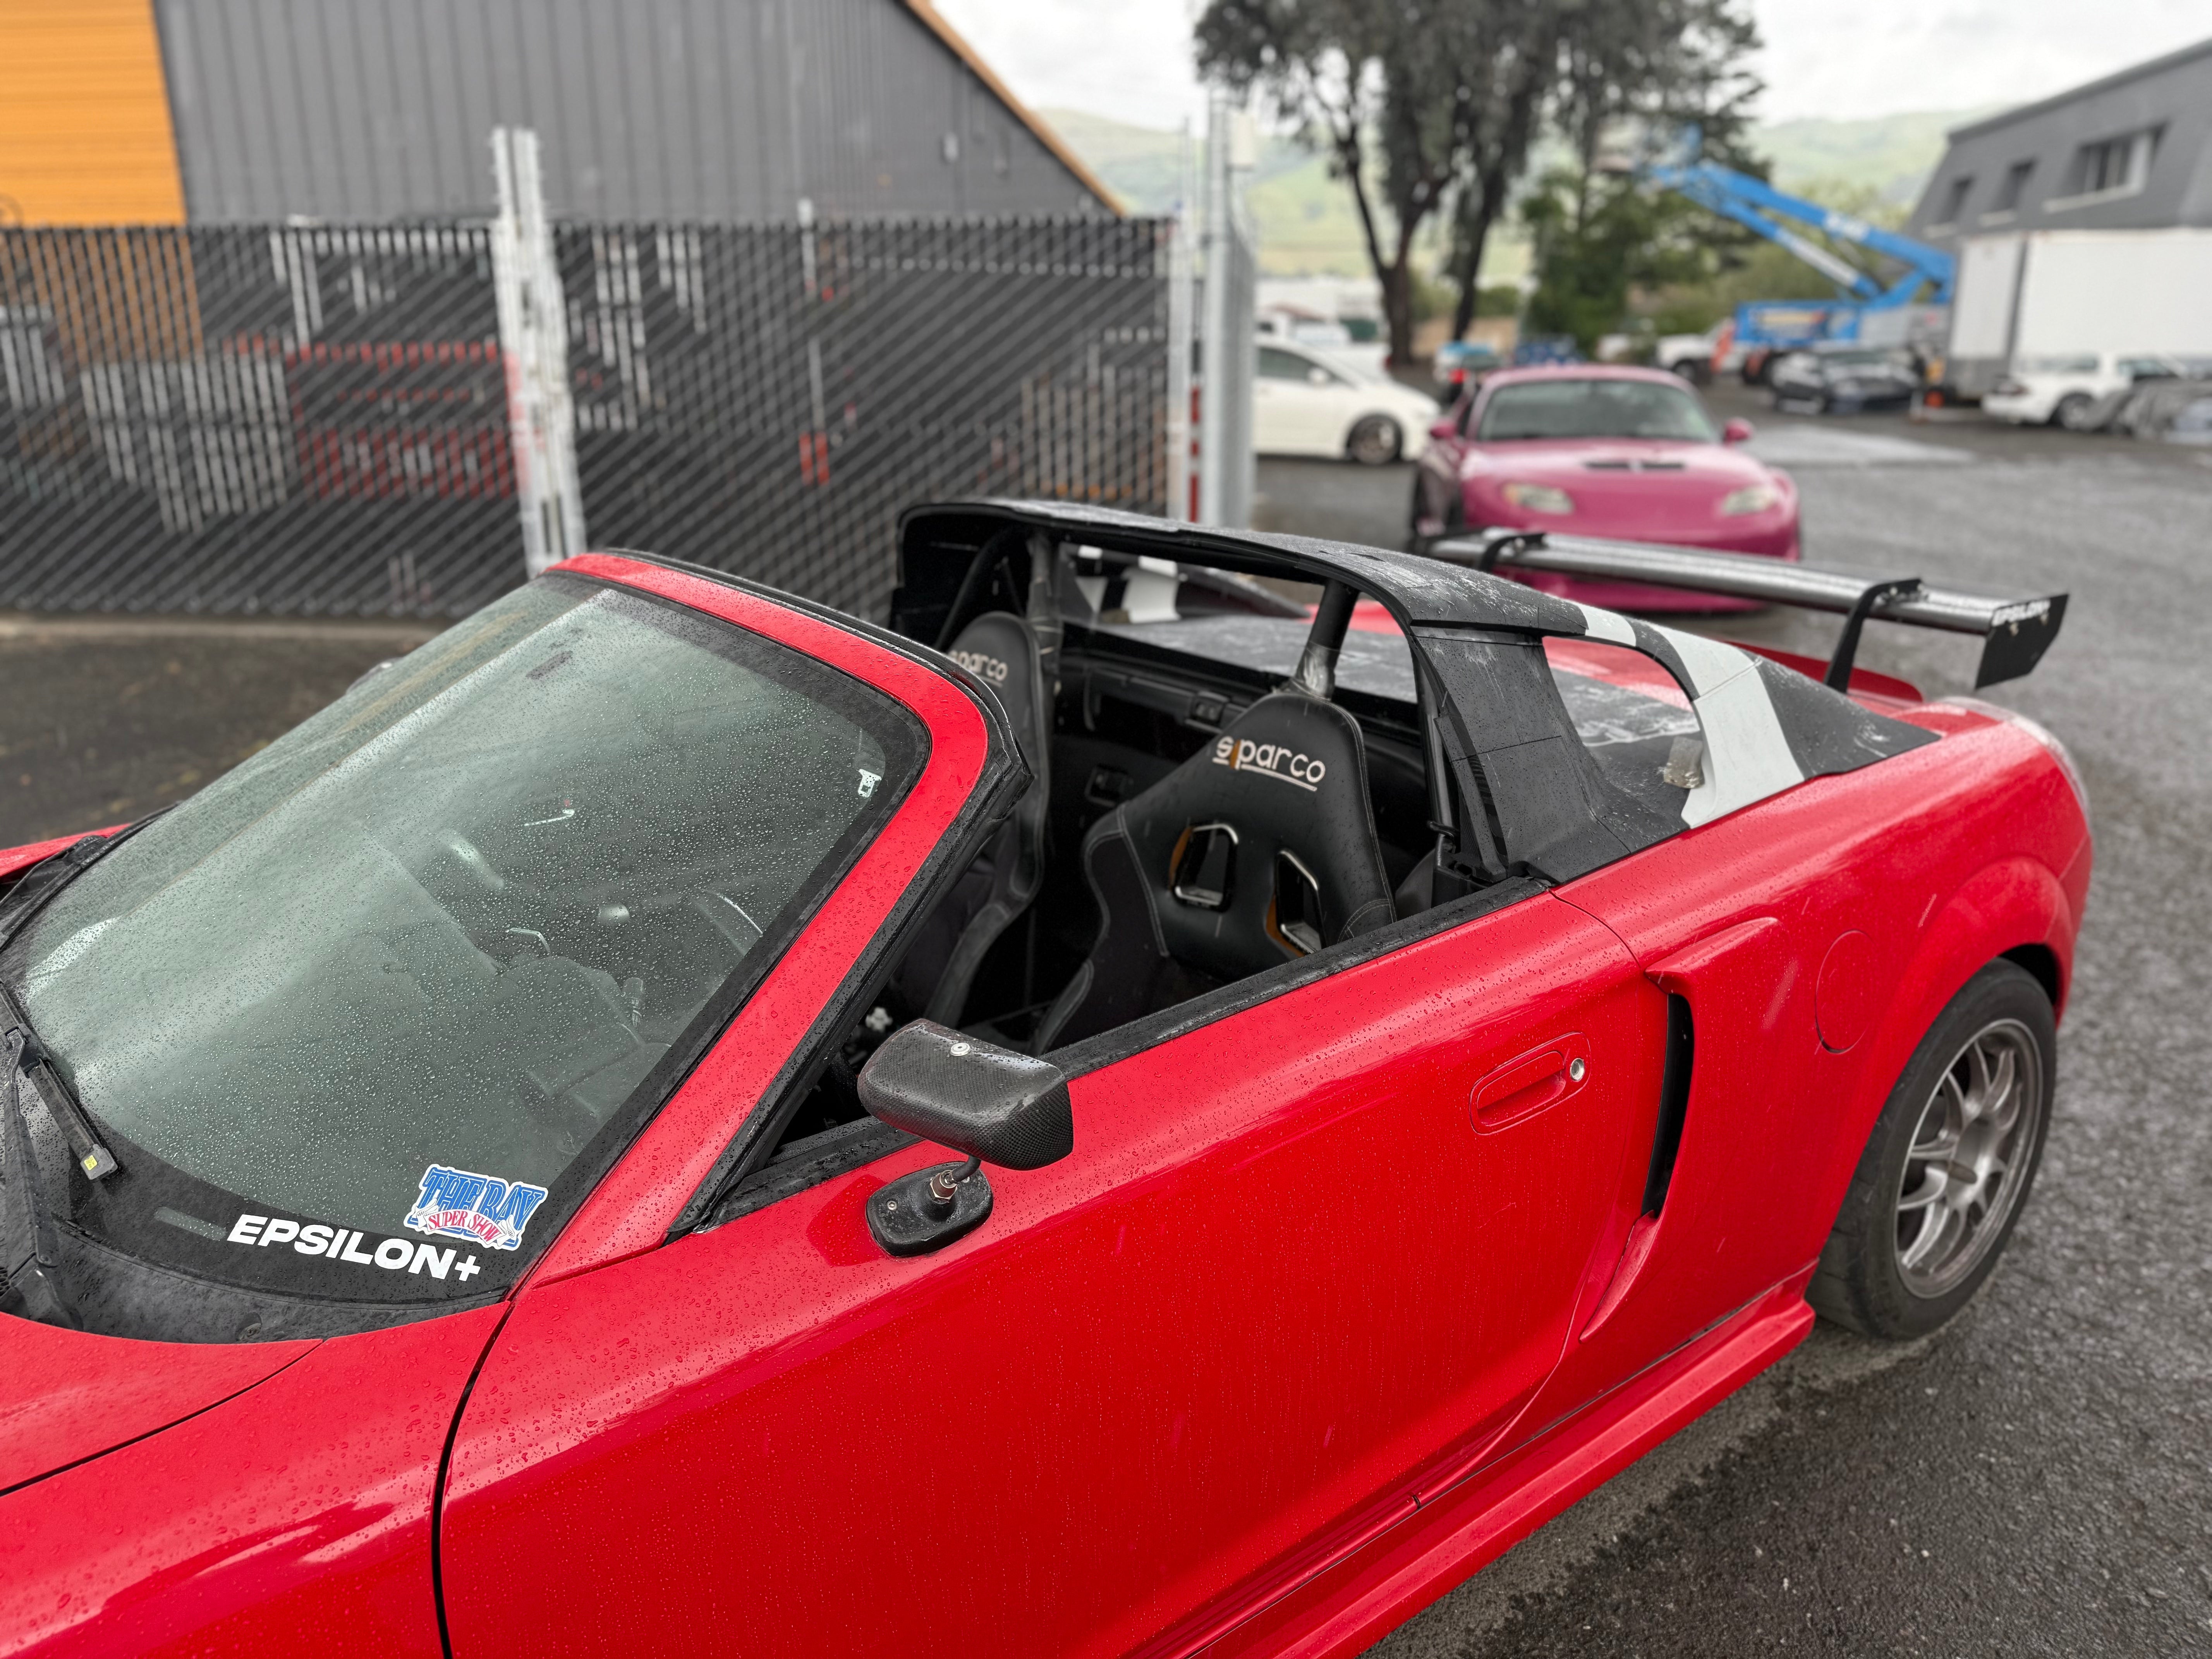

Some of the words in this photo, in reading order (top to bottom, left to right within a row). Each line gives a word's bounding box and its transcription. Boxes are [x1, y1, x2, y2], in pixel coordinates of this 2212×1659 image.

[1216, 735, 1325, 783] sparco
[407, 1167, 487, 1235] THE
[463, 1180, 545, 1247] BAY
[428, 1211, 467, 1230] SUPER
[467, 1214, 502, 1242] SHOW
[227, 1214, 481, 1281] EPSILON+
